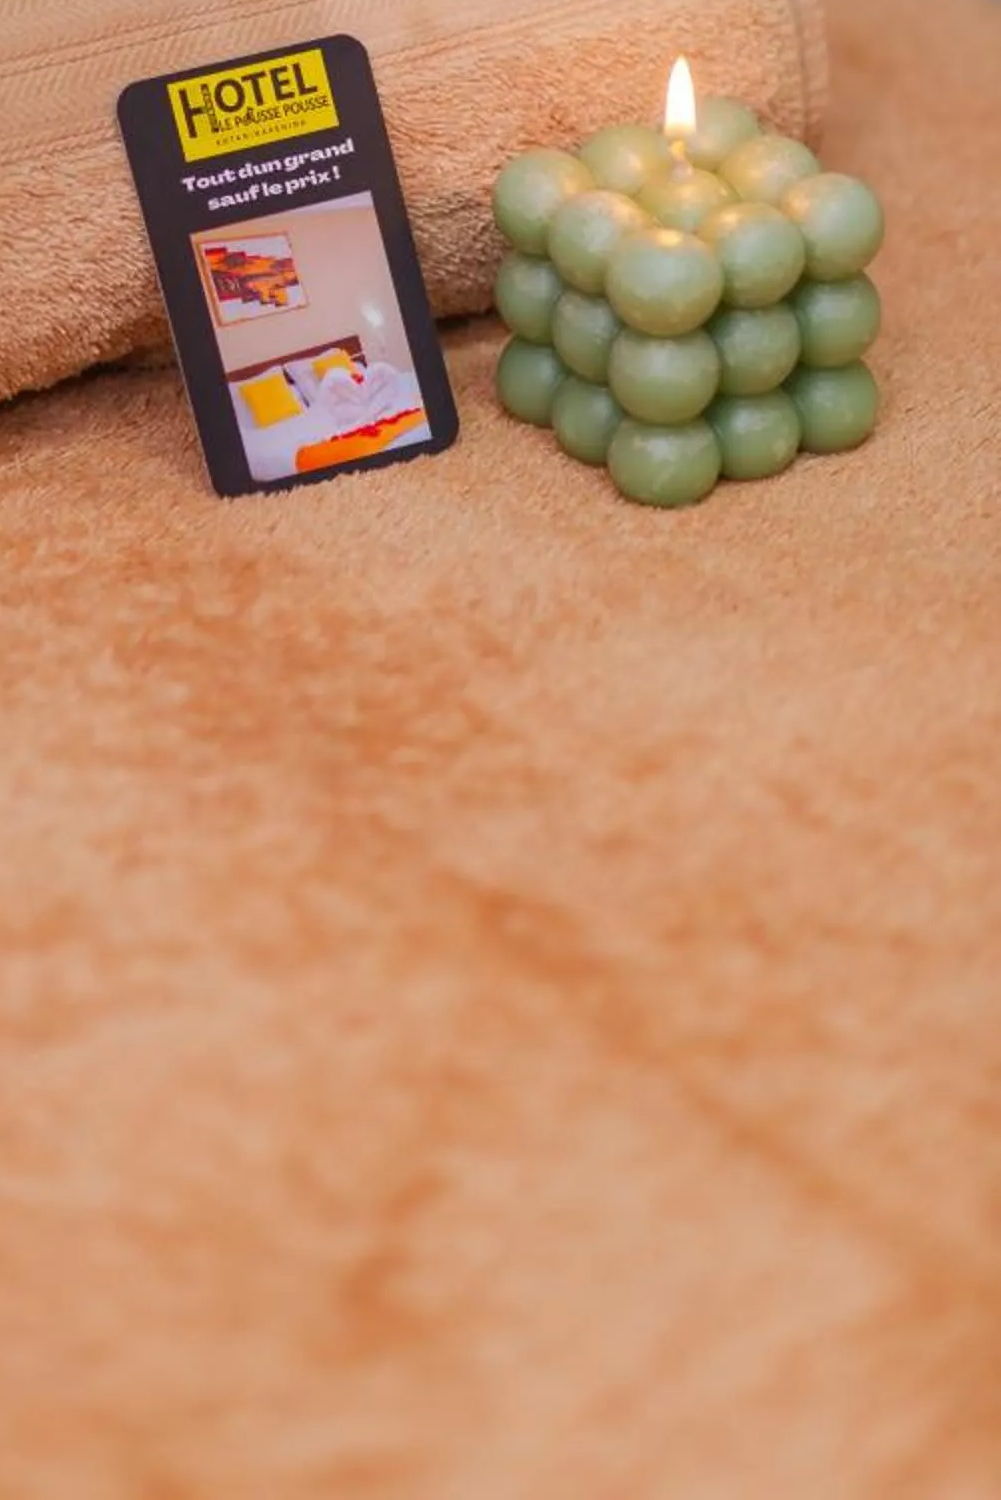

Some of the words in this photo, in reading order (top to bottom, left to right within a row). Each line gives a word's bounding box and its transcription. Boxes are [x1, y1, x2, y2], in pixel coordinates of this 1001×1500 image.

[178, 62, 318, 139] HOTEL
[284, 95, 330, 116] POUSSE
[181, 168, 237, 192] Tout
[283, 137, 355, 172] grand
[207, 182, 261, 211] sauf
[261, 181, 284, 197] le
